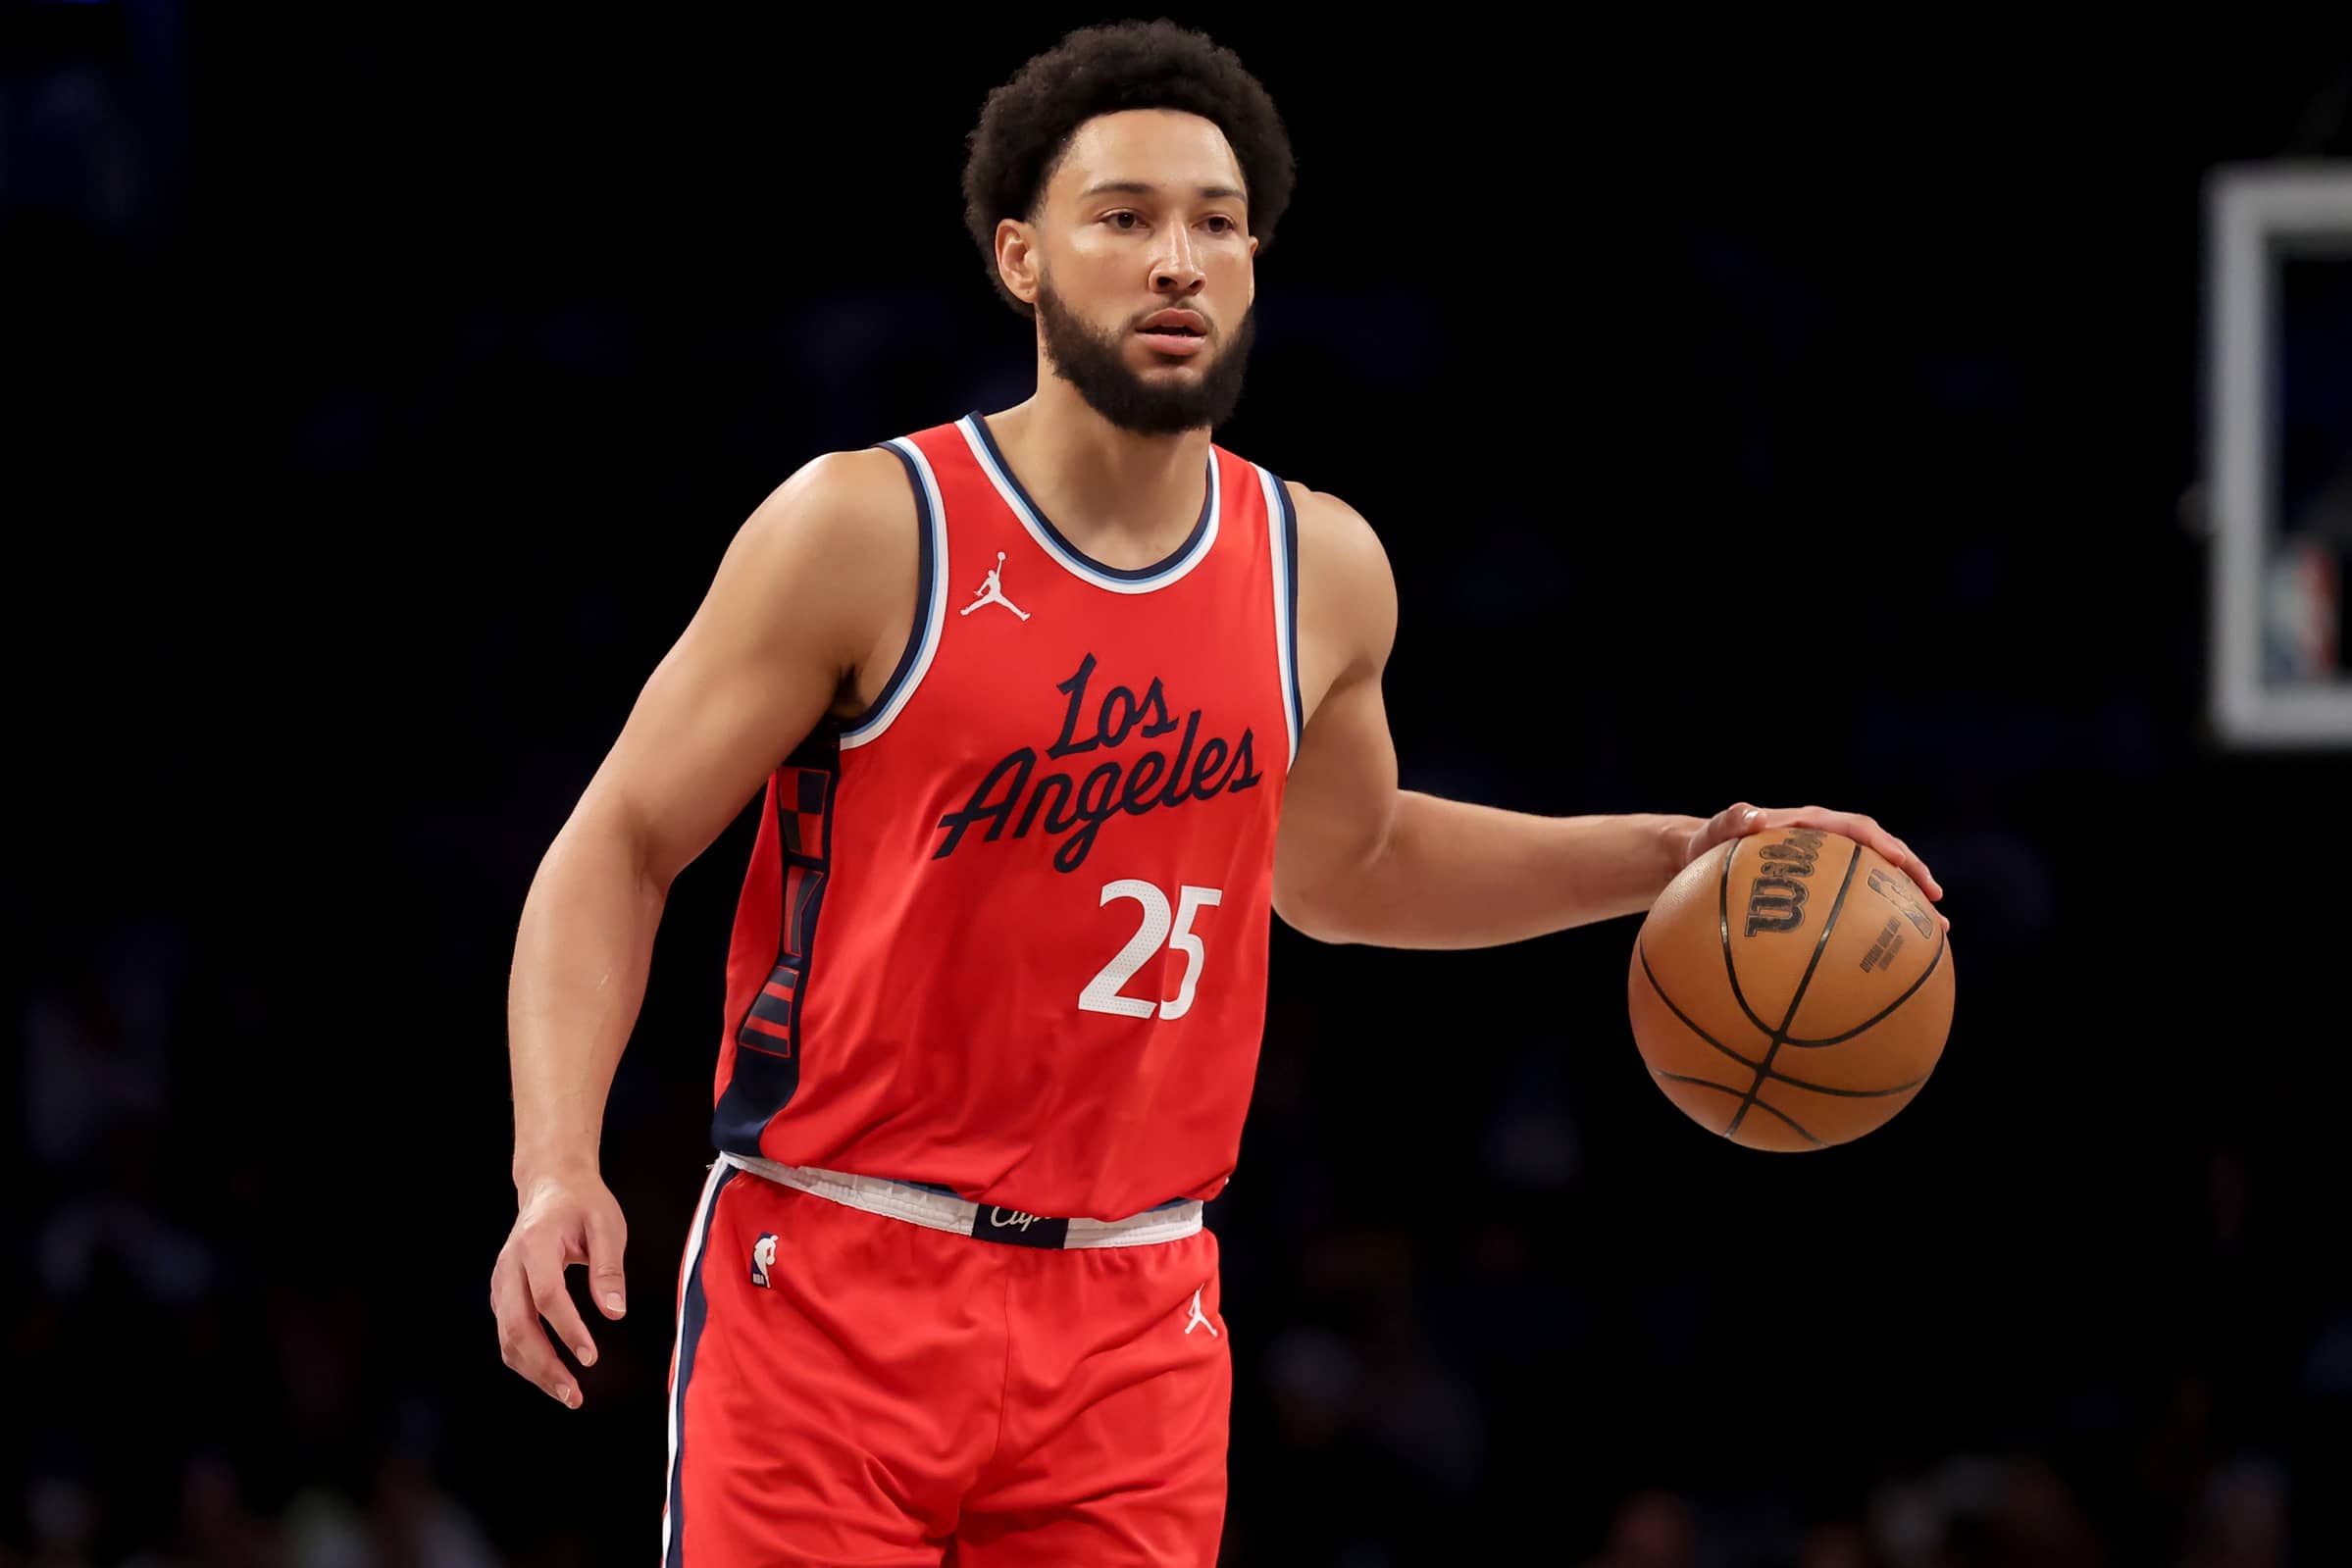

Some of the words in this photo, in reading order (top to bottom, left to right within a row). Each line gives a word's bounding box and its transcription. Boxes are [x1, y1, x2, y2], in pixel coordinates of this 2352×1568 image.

[1046, 652, 1179, 760] Los
[932, 710, 1262, 873] Angeles
[1078, 879, 1223, 1020] 25
